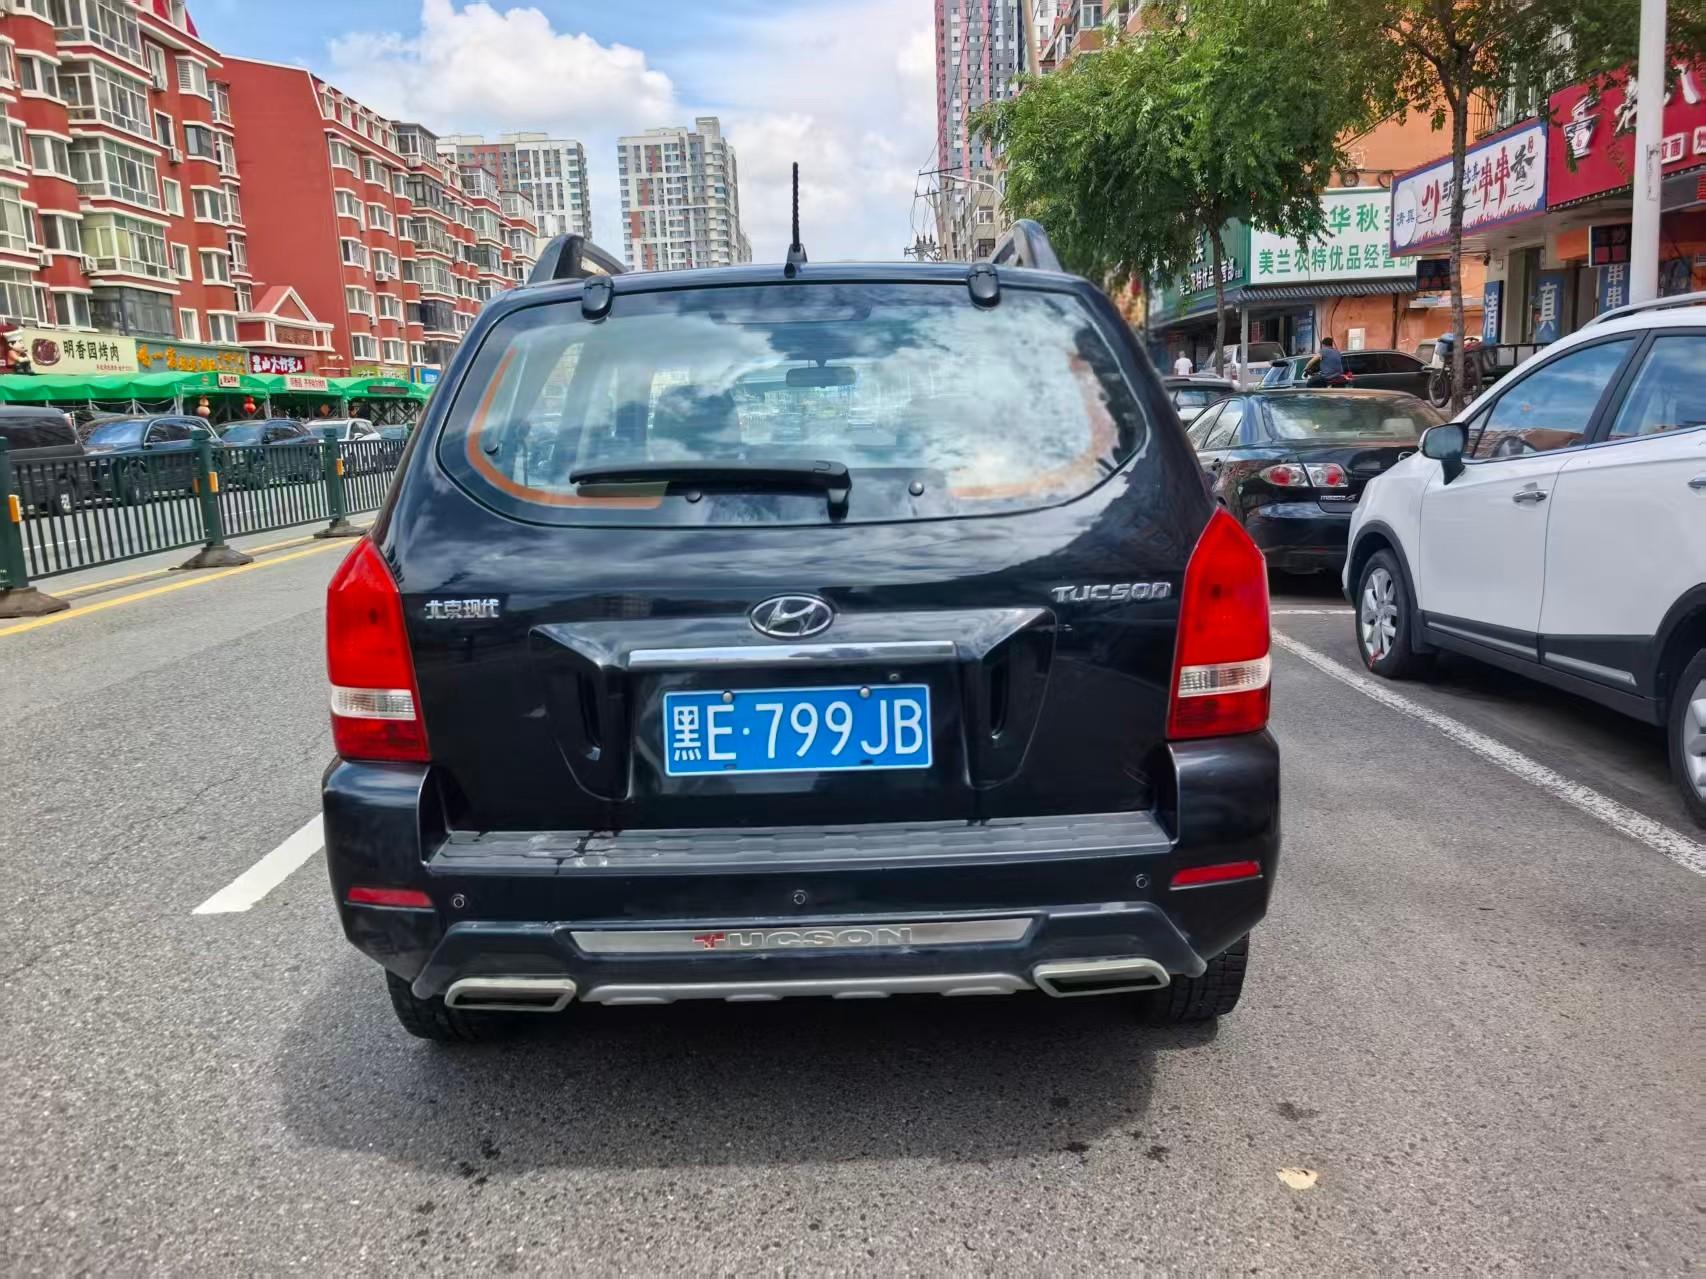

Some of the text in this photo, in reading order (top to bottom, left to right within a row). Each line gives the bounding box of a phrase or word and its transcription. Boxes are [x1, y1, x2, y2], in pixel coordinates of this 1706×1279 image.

[1483, 292, 1499, 338] 清
[1539, 282, 1558, 331] 真
[62, 340, 120, 362] 明香园烤肉
[424, 598, 500, 619] 北京现代
[692, 928, 912, 950] TUCSON
